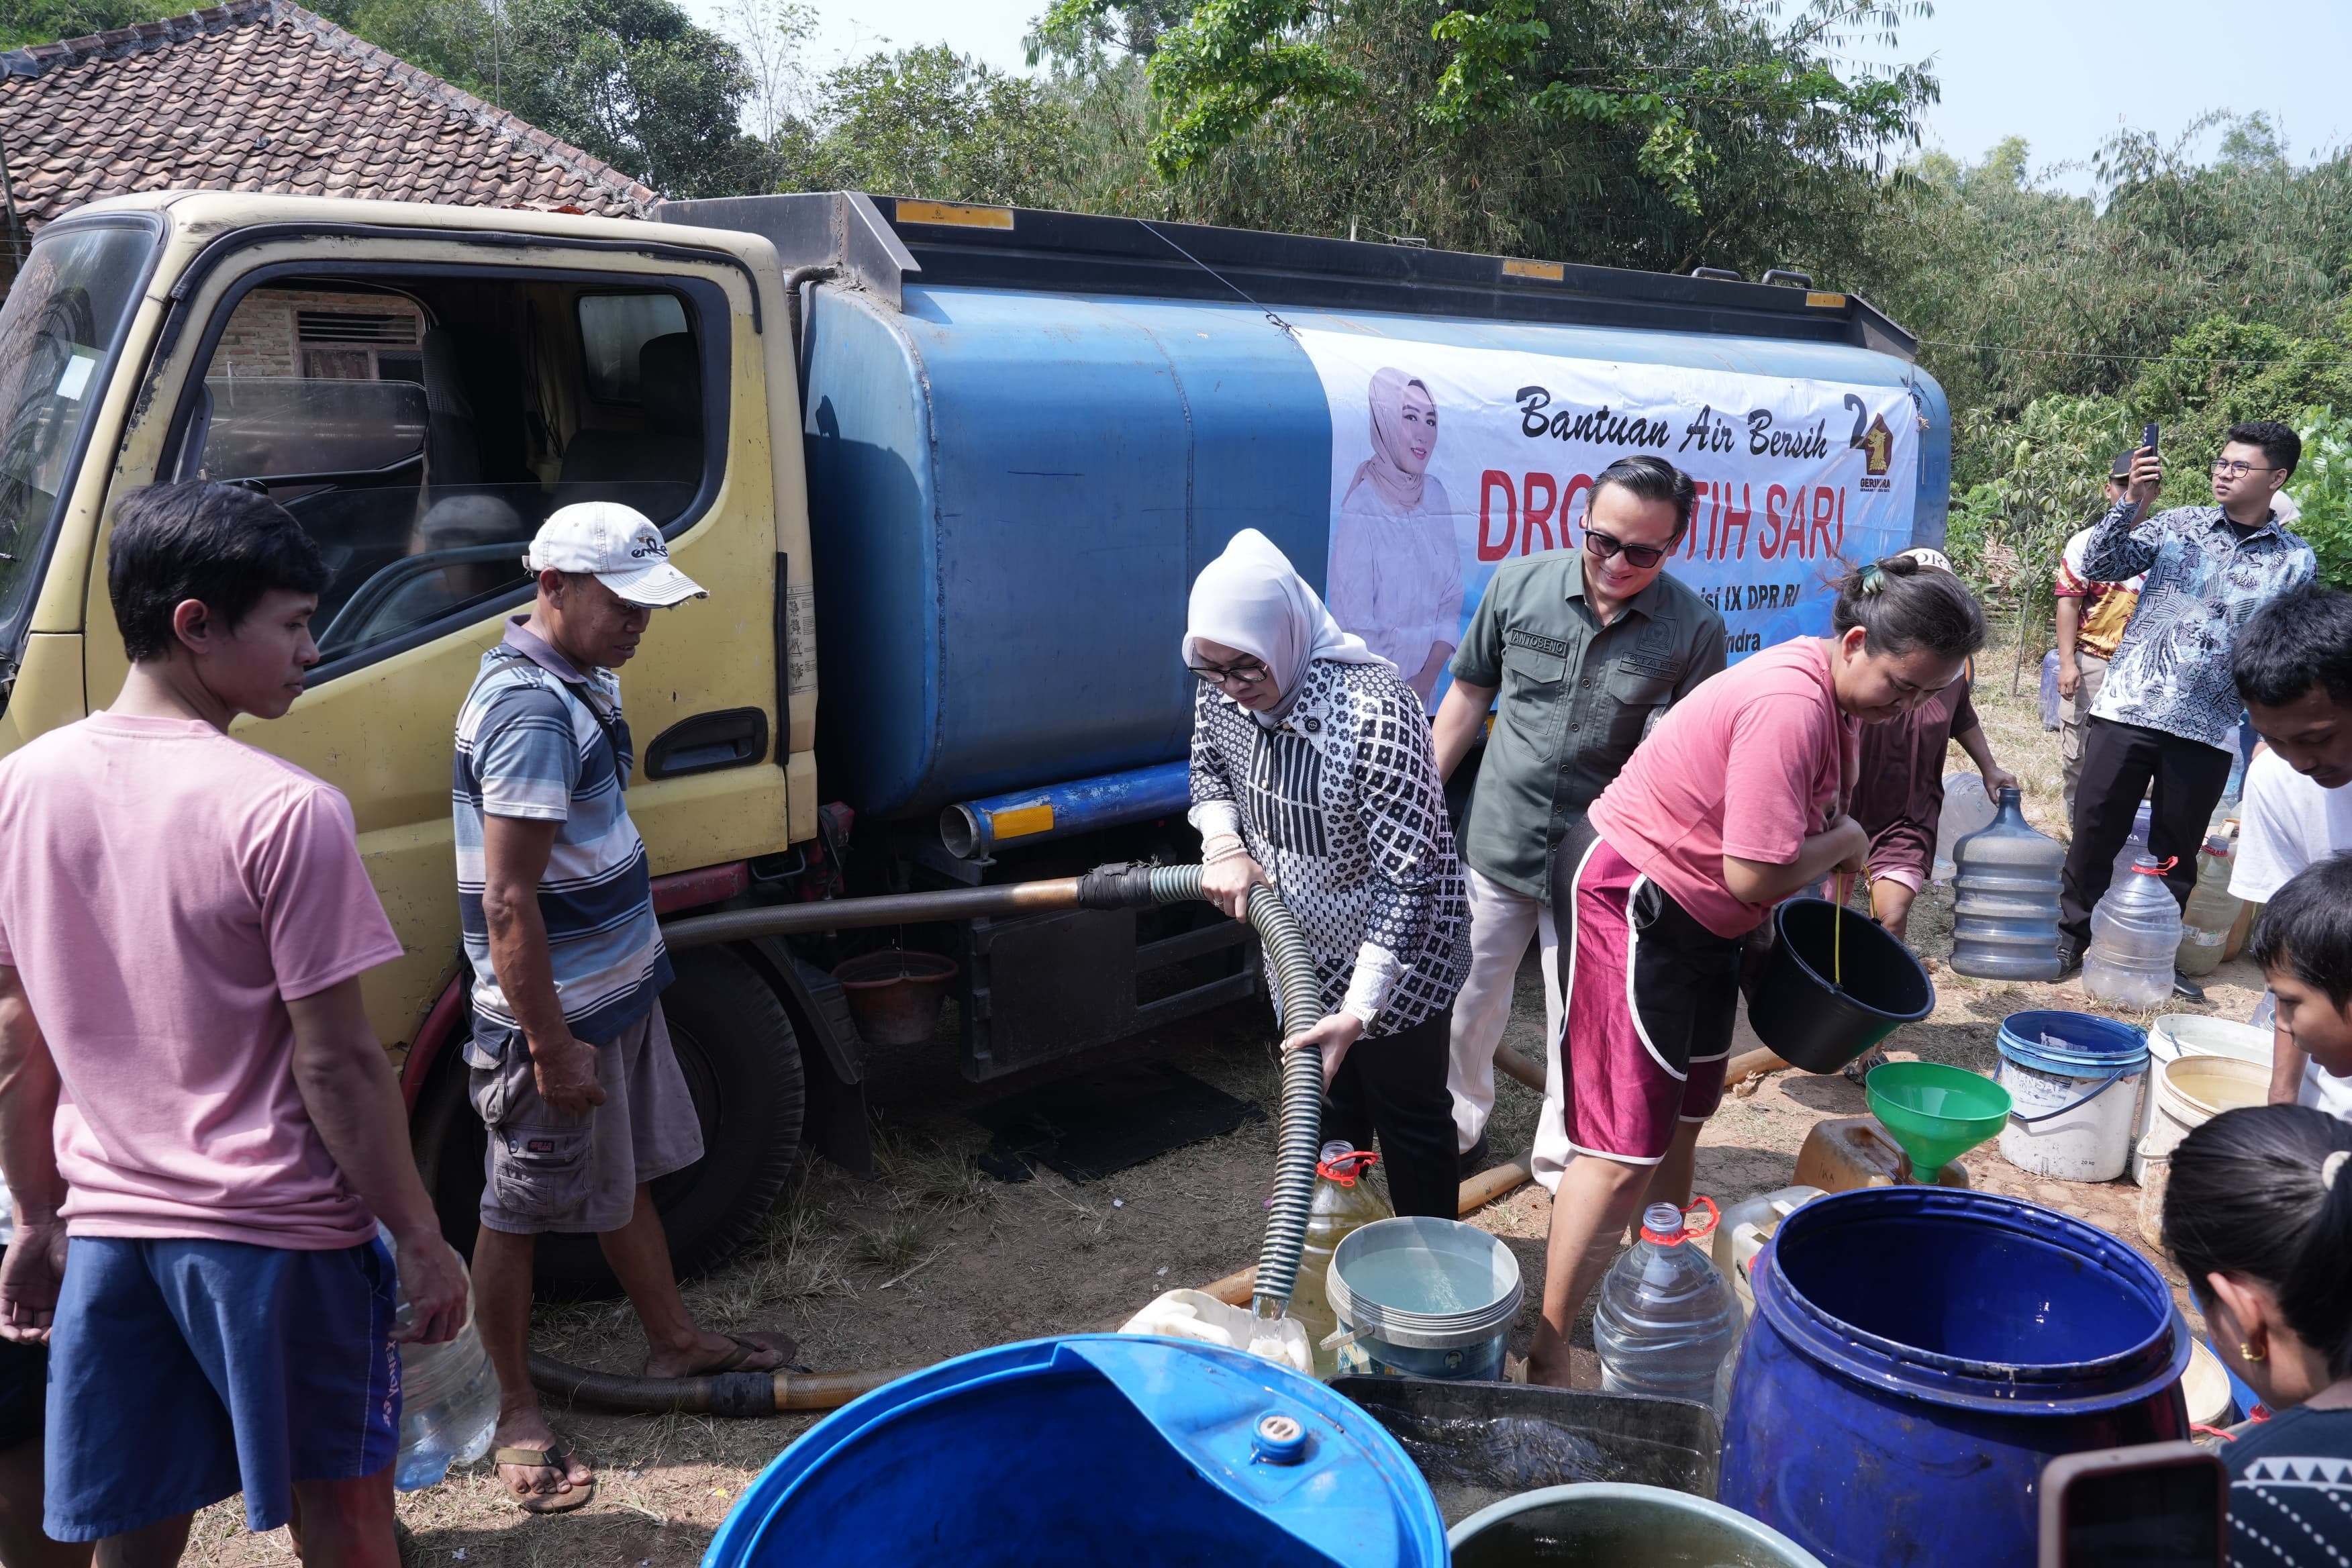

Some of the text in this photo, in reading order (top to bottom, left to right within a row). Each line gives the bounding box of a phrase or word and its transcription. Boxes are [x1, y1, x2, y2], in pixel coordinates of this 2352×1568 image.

[1516, 385, 1828, 460] Bantuan Air Bersih
[1758, 483, 1845, 560] SARI
[1724, 585, 1743, 611] IX
[1747, 585, 1780, 610] DPR
[1781, 584, 1801, 608] RI
[1512, 630, 1564, 653] ANTOSENO
[385, 1340, 399, 1399] YONEX
